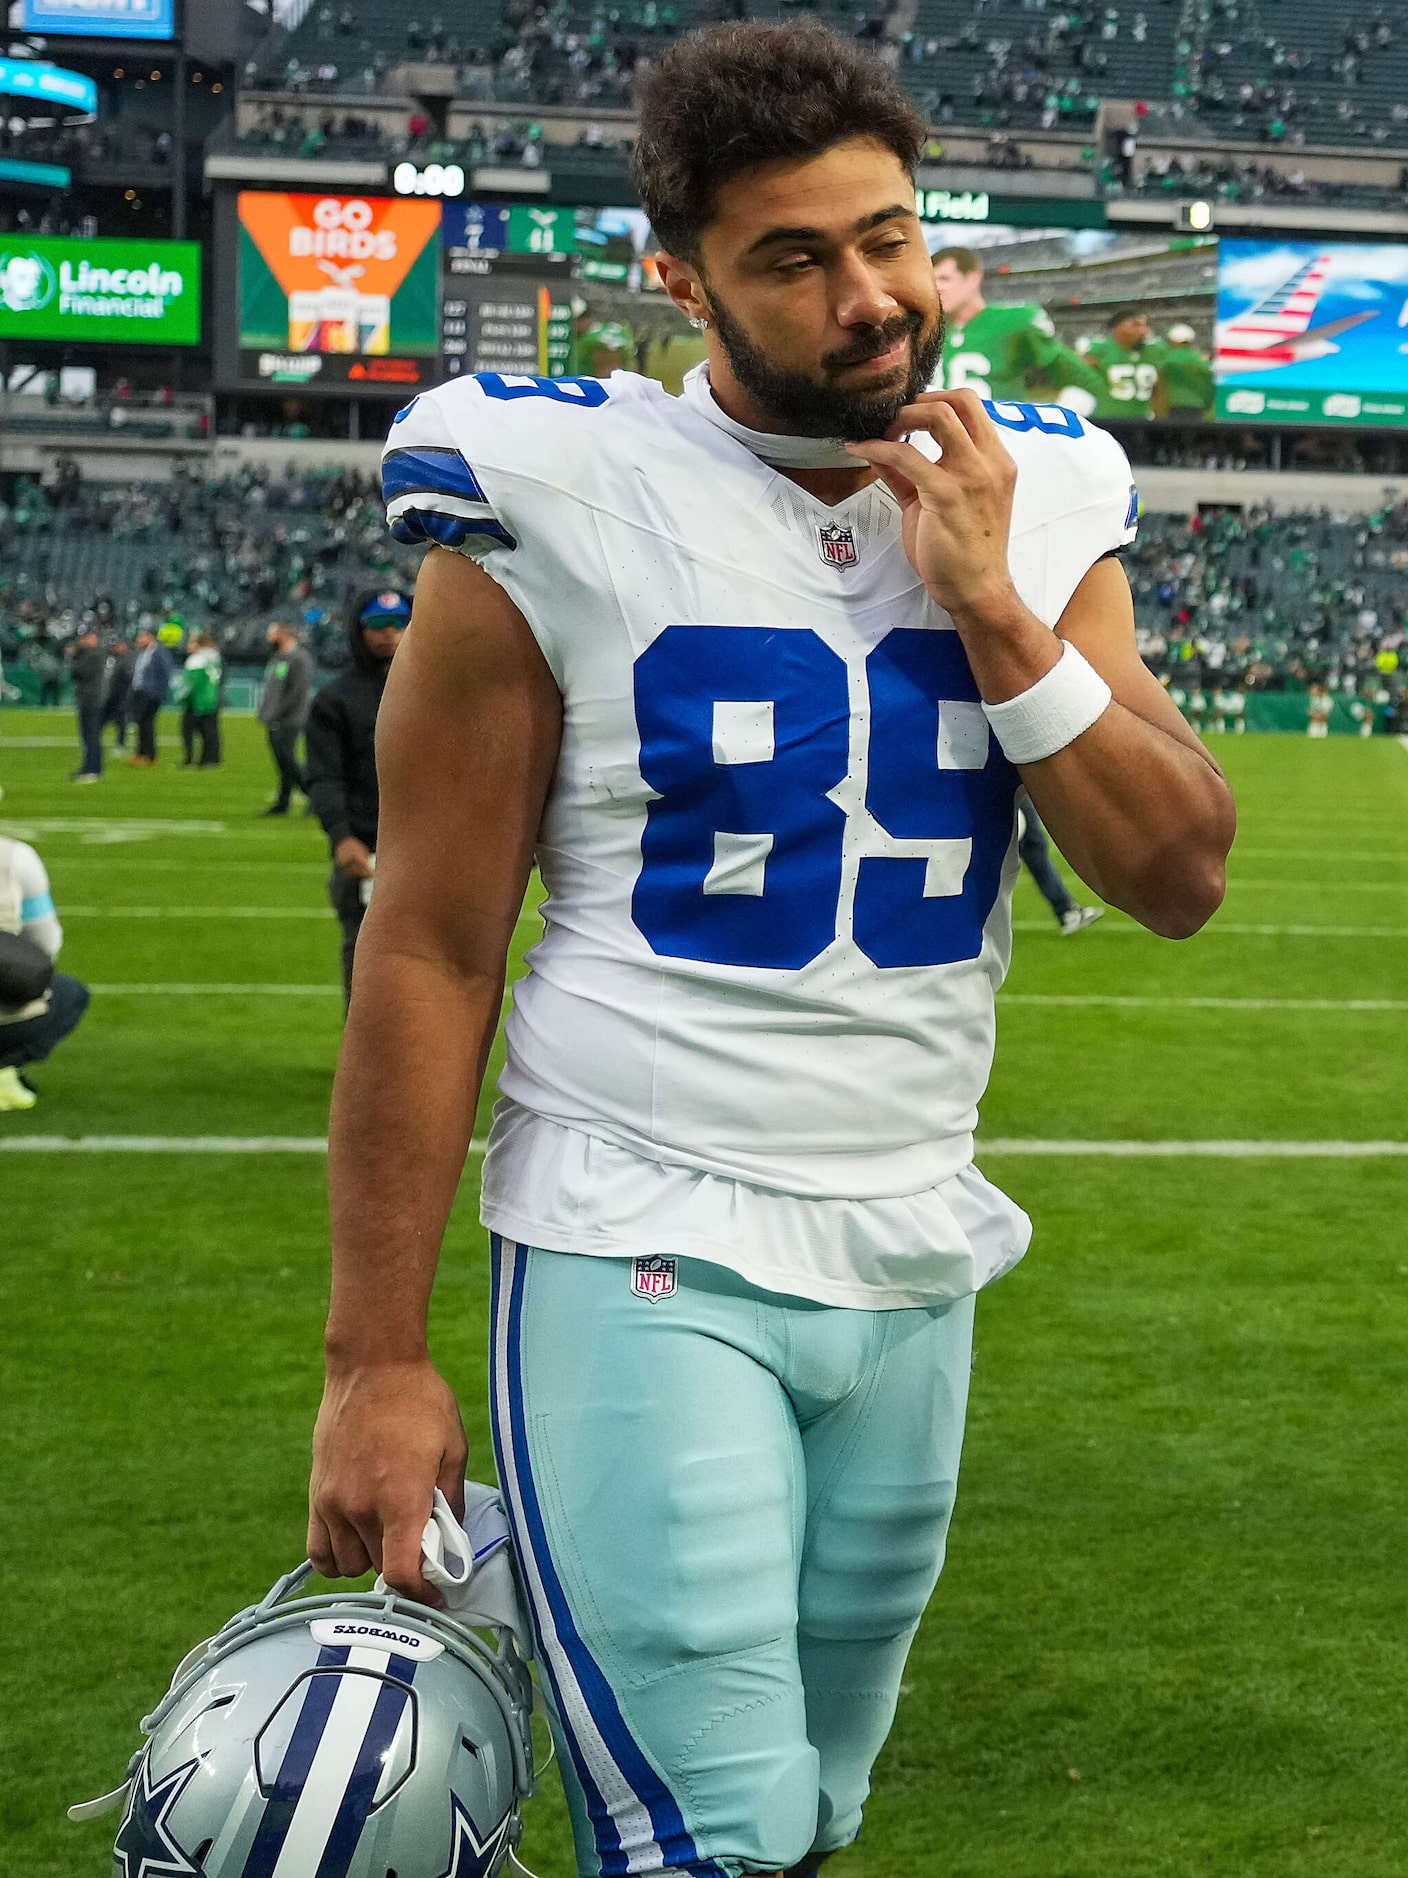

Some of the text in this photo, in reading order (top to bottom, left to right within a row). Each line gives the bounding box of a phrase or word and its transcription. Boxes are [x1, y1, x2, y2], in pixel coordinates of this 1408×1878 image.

[313, 199, 373, 231] GO
[289, 226, 397, 260] BIRDS
[59, 260, 183, 296] Lincoln
[59, 293, 164, 318] Financial
[825, 542, 853, 562] NFL
[631, 624, 1018, 970] 89
[639, 1273, 671, 1293] NFL
[333, 1625, 421, 1648] COWBOYS
